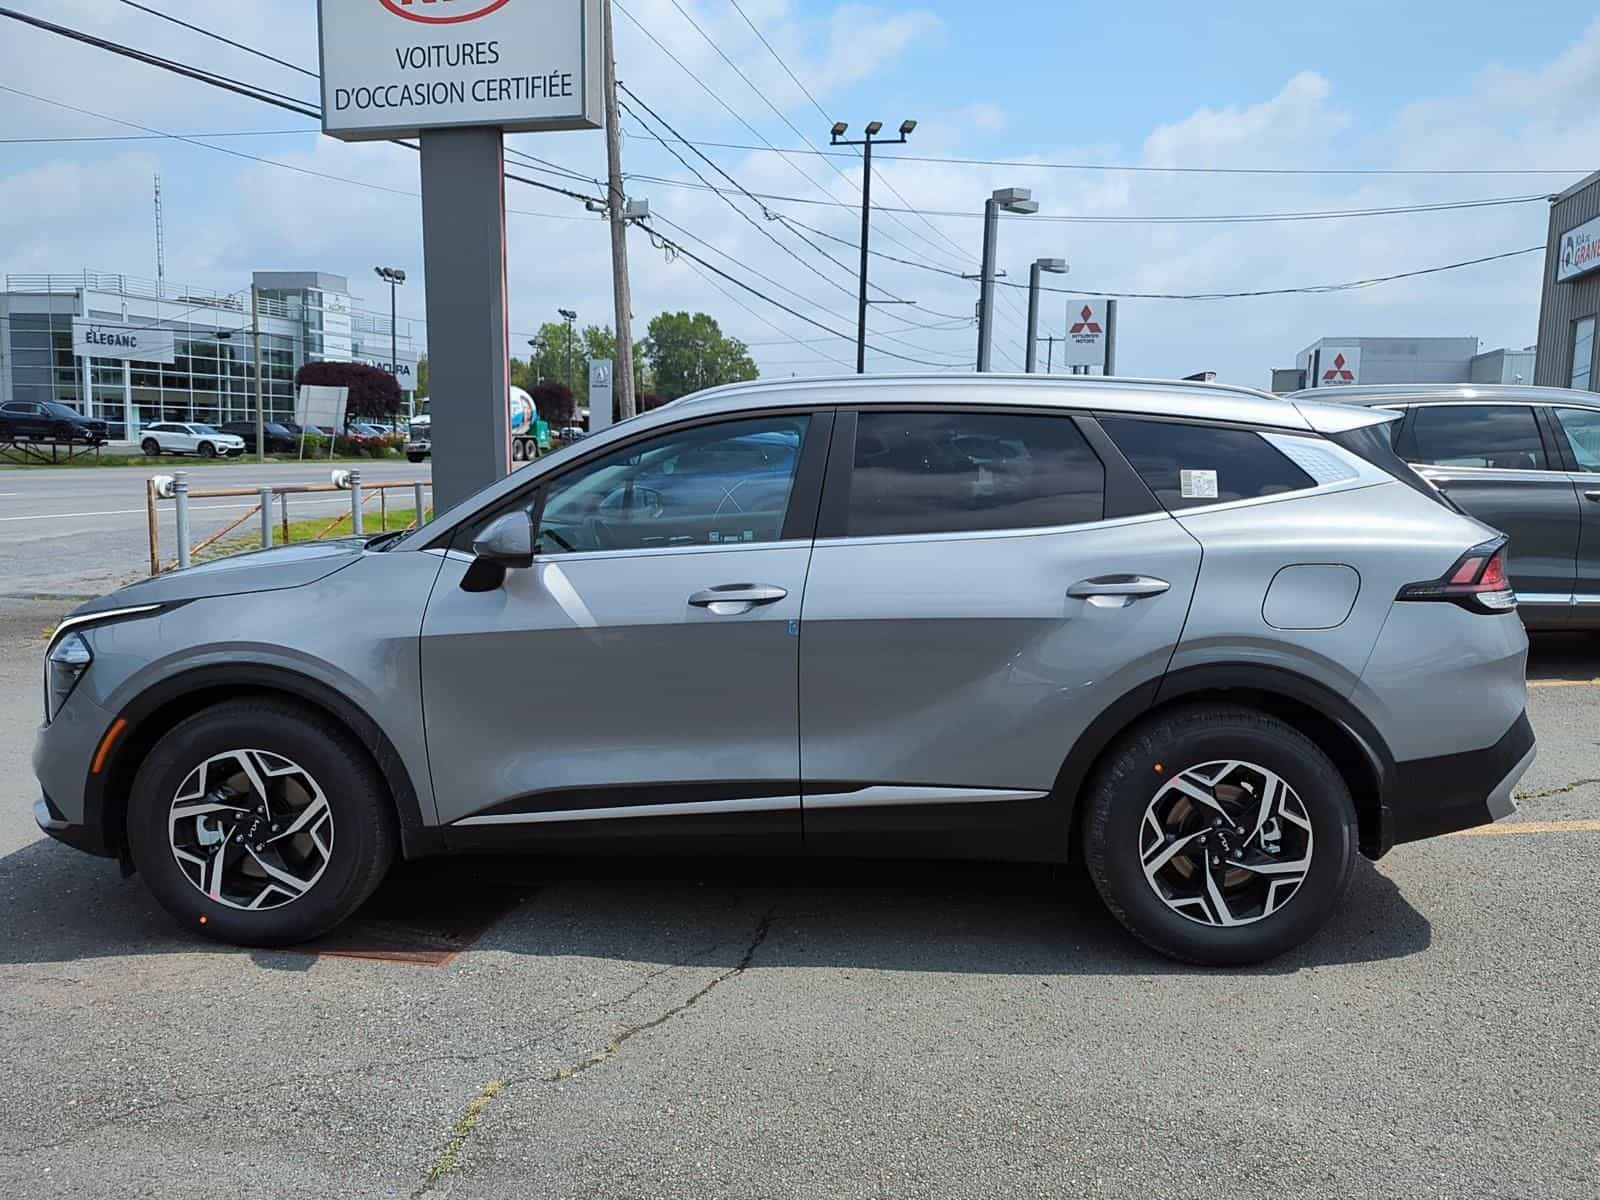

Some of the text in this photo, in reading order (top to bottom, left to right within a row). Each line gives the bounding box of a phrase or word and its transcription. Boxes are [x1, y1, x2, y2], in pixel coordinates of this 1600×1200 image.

[396, 41, 500, 70] VOITURES
[335, 70, 573, 111] D'OCCASION CERTIFIÉE
